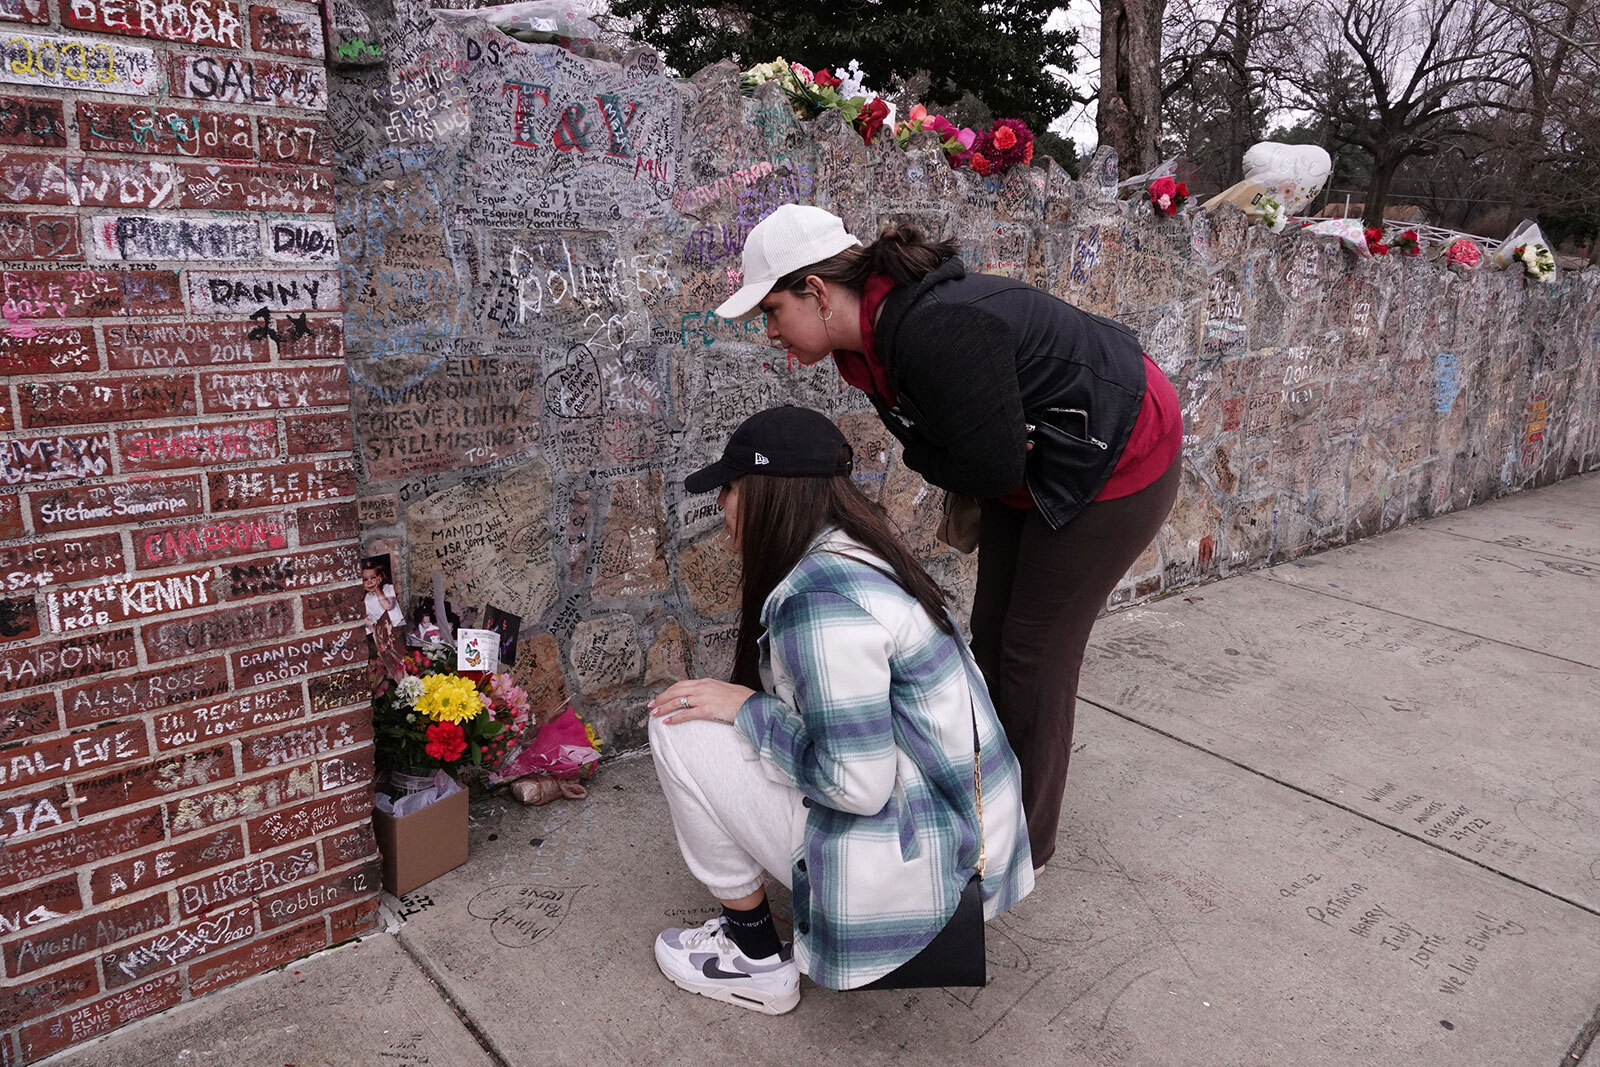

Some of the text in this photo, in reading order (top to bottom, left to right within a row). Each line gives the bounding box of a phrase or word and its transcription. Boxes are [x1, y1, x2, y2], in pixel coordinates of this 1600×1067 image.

[8, 37, 121, 84] 2022
[208, 278, 320, 311] DANNY
[125, 347, 190, 367] TARA
[270, 486, 340, 504] BUTLER
[144, 520, 267, 562] CAMERON
[62, 586, 116, 608] KYLE
[120, 570, 211, 616] KENNY
[240, 636, 324, 668] BRANDON
[253, 660, 309, 685] BRODY
[73, 683, 140, 712] ALLY
[69, 978, 163, 1023] WE LOVE YOU
[71, 1010, 111, 1033] ELVIS
